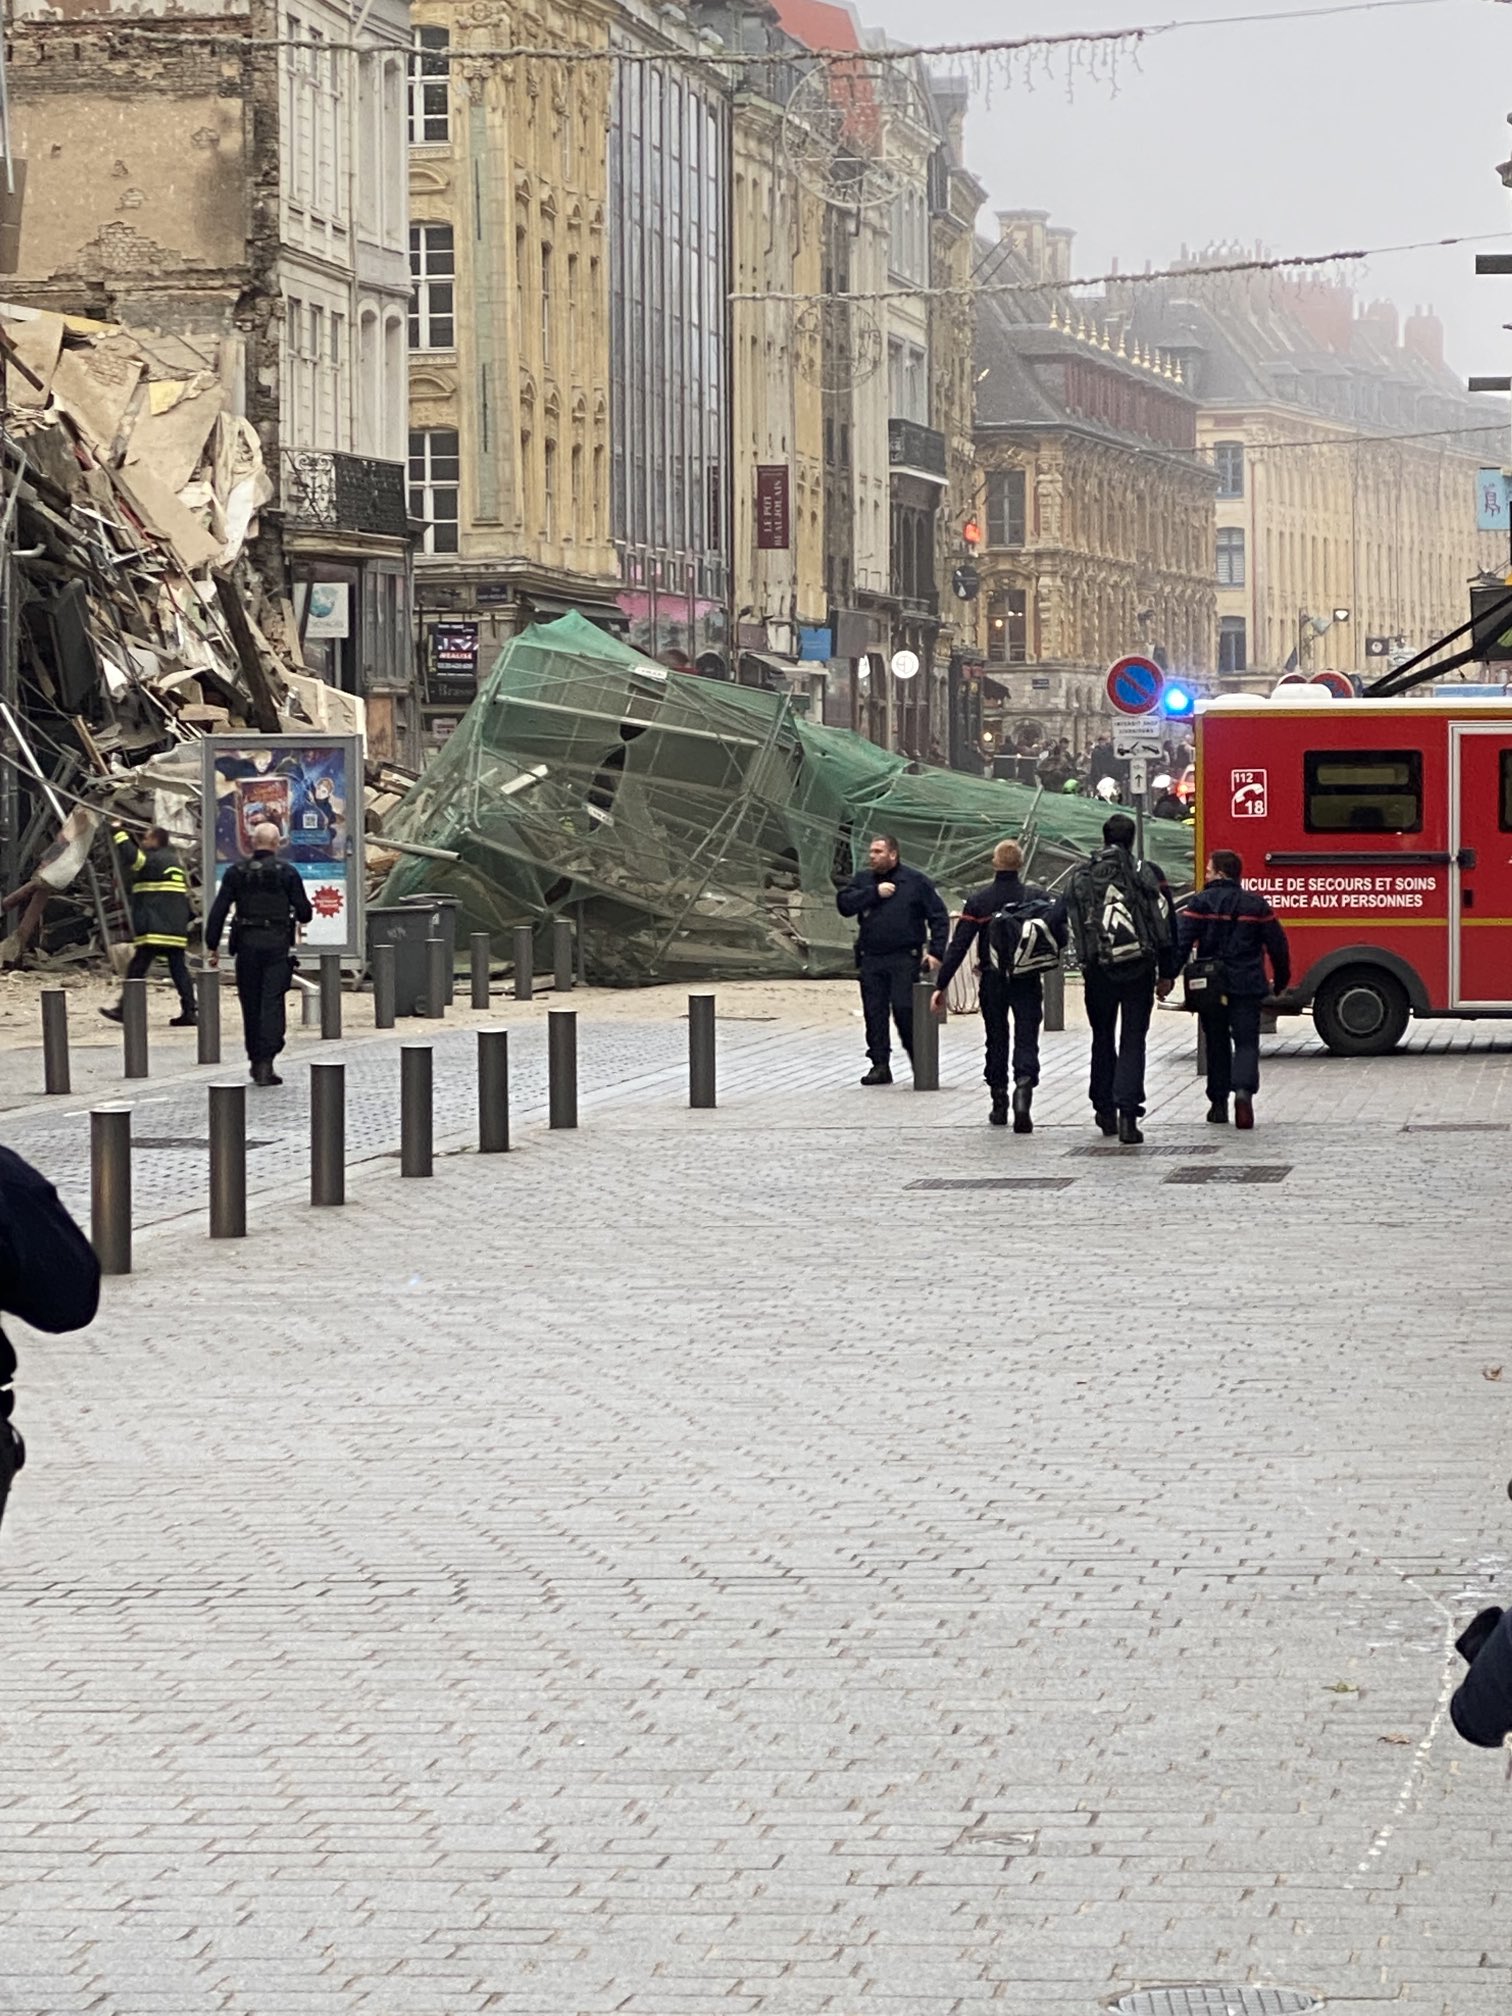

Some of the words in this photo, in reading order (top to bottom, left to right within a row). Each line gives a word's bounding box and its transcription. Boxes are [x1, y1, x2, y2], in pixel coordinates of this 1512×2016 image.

[763, 496, 772, 516] POT
[1234, 772, 1254, 783] 112
[1244, 800, 1265, 815] 18
[1287, 878, 1305, 891] DE
[1308, 878, 1372, 891] SECOURS
[1375, 877, 1393, 891] ET
[1395, 877, 1436, 891] SOINS
[1310, 894, 1339, 907] AUX
[1341, 894, 1423, 908] PERSONNES
